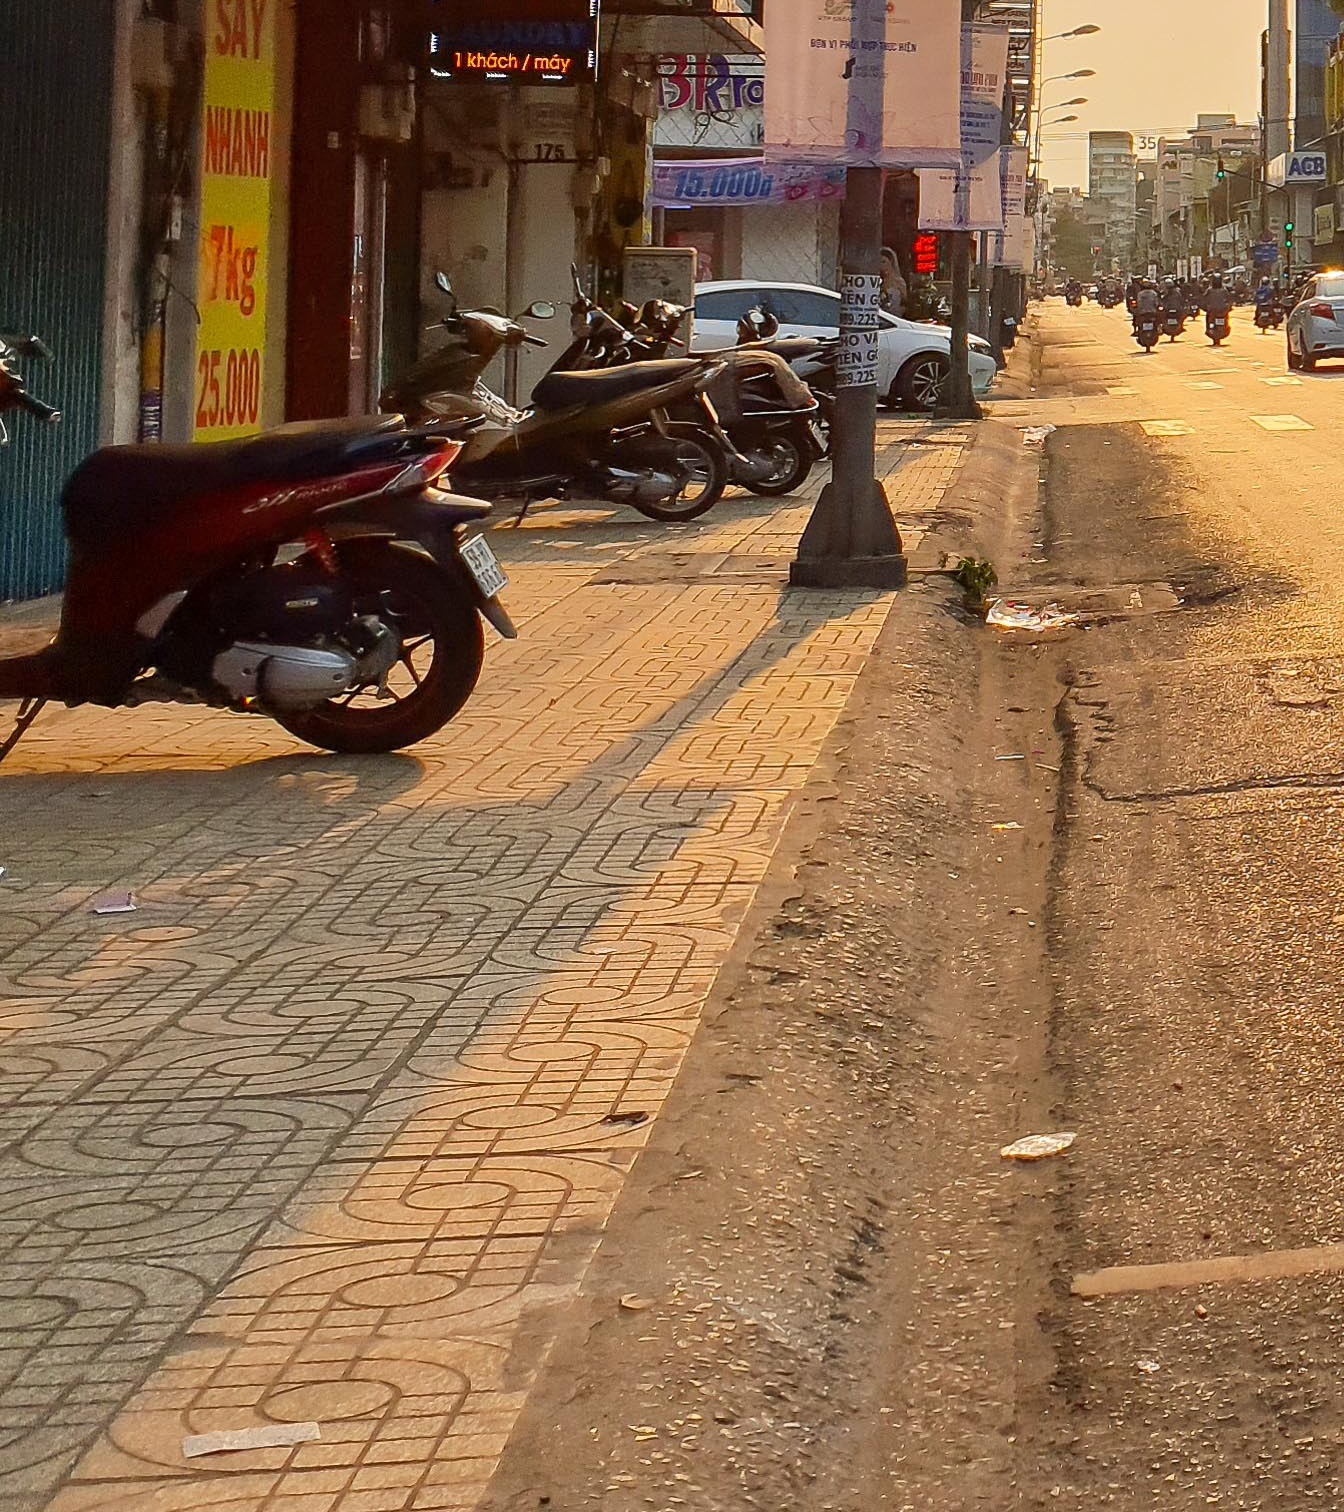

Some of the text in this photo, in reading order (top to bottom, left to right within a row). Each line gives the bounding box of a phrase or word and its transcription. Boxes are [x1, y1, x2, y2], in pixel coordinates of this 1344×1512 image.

[454, 52, 461, 68] 1
[467, 51, 518, 69] khách
[534, 53, 571, 73] máy
[205, 105, 271, 179] NHANH
[534, 143, 566, 160] 175
[1289, 157, 1325, 176] ACB
[208, 224, 259, 319] 7kg
[195, 348, 261, 426] 25.000
